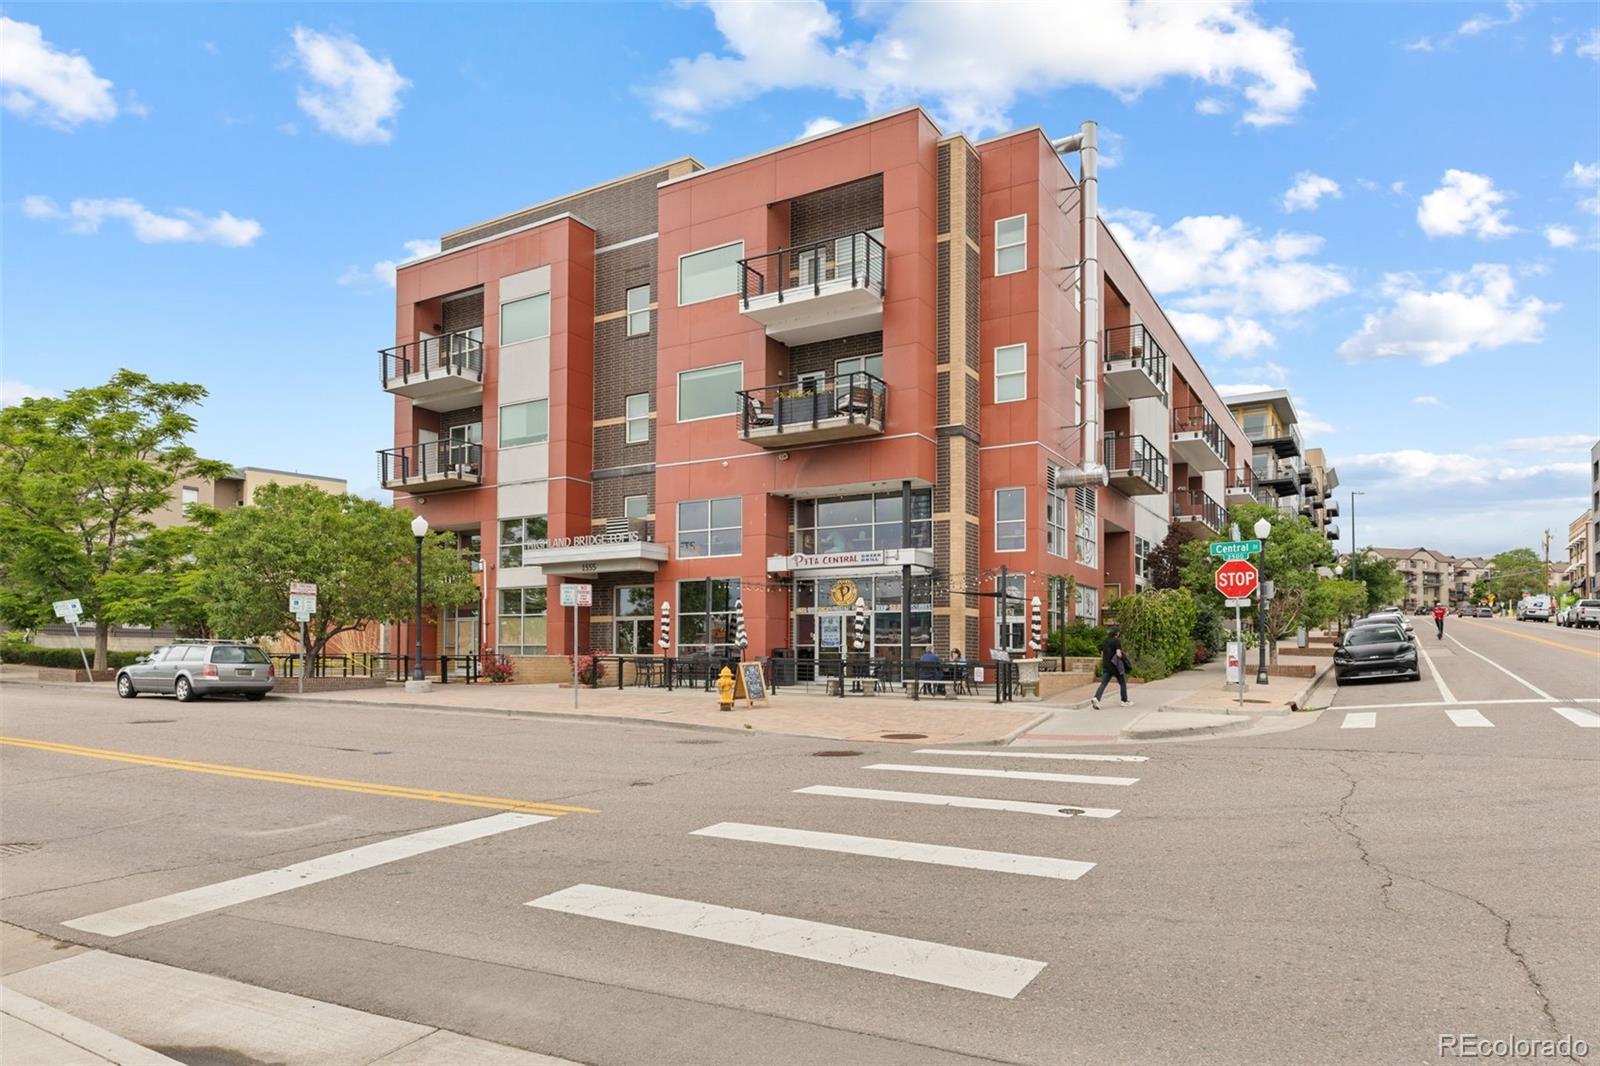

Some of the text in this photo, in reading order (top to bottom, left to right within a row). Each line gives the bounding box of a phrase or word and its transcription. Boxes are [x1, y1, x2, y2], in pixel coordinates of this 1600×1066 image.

[573, 533, 608, 547] BRIDGE
[1215, 543, 1249, 554] Central
[794, 554, 858, 567] PITA CENTRAL
[582, 563, 597, 572] 1555
[1219, 572, 1255, 587] STOP
